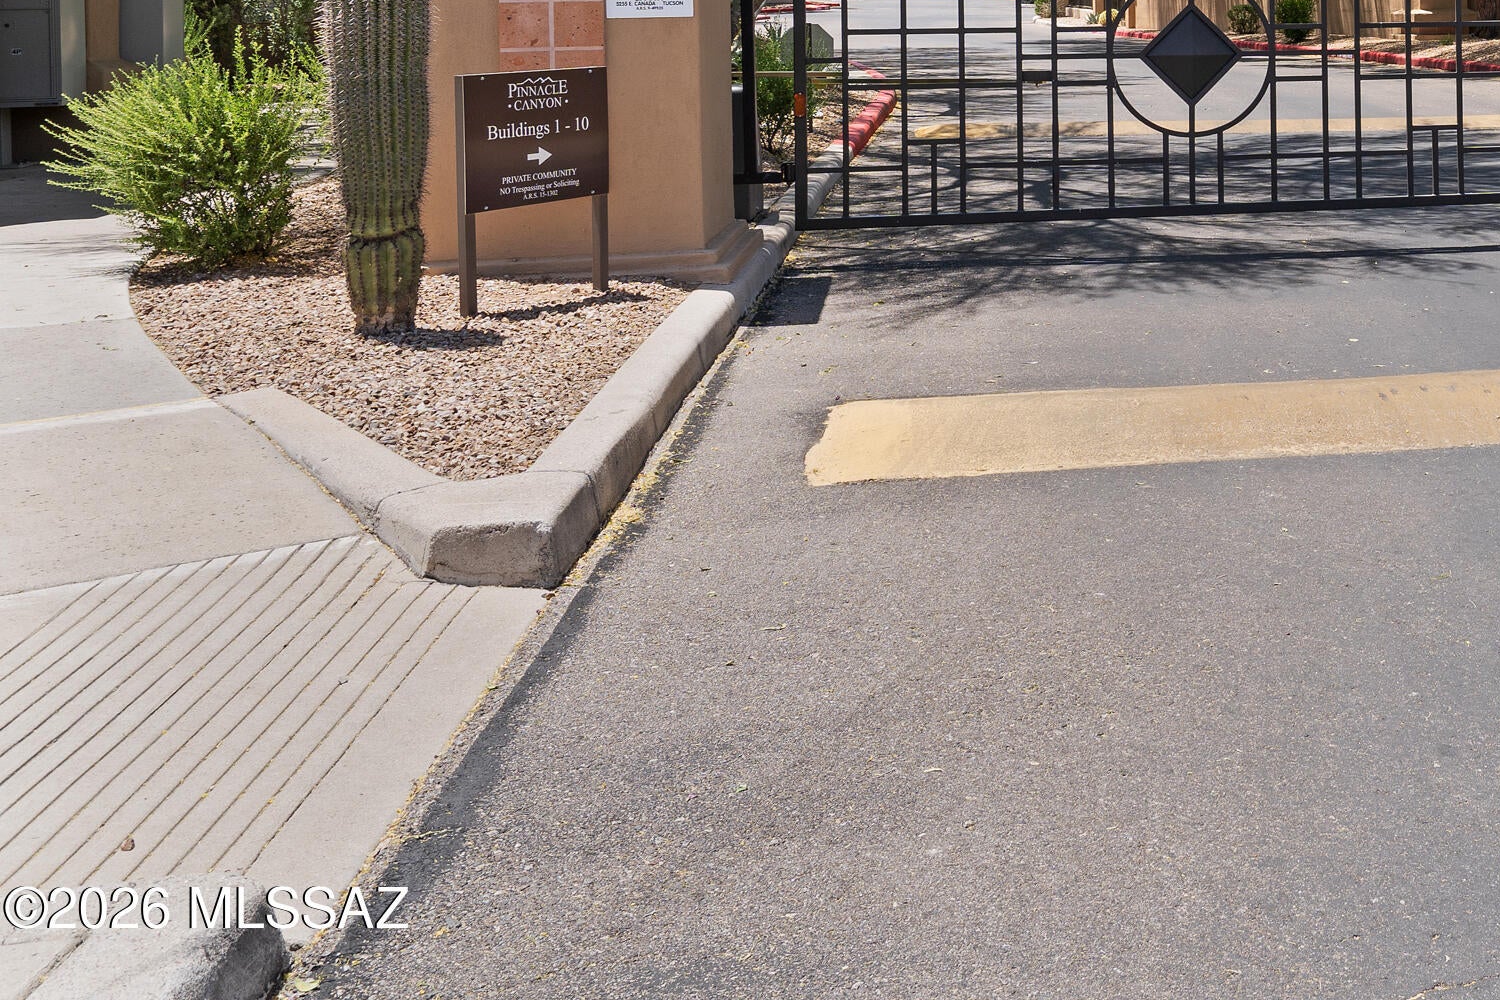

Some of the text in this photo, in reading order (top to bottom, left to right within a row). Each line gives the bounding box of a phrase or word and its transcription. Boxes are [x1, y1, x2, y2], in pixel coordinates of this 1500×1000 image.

[508, 80, 568, 98] PINNACLE
[514, 97, 562, 111] CANYON
[488, 122, 550, 140] Buildings
[555, 119, 560, 133] 1
[575, 116, 589, 131] 10
[502, 168, 577, 184] PRIVATE COMMUNITY
[512, 184, 545, 194] Trespassing
[553, 179, 580, 188] Soliciting
